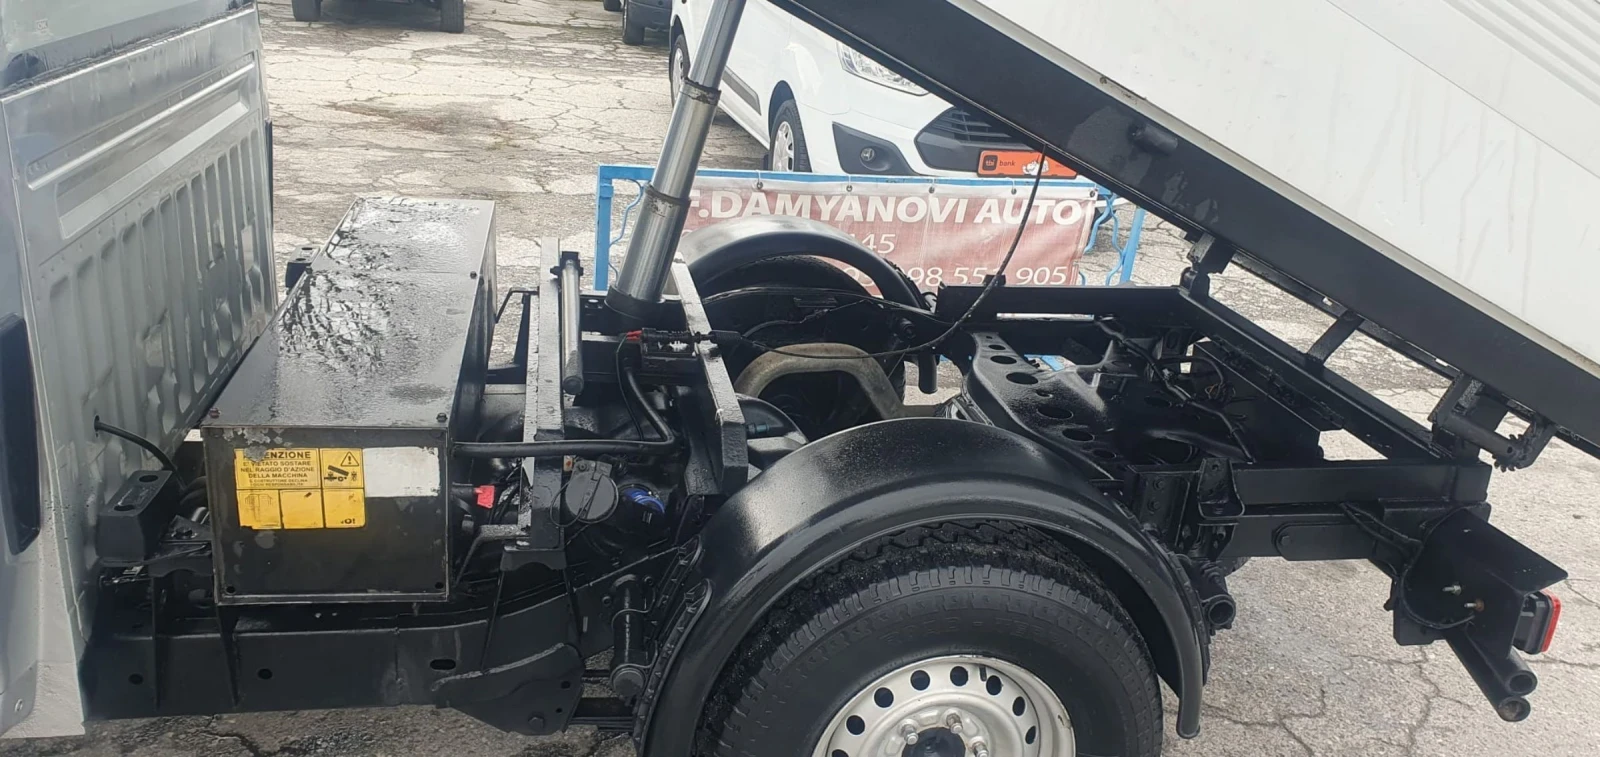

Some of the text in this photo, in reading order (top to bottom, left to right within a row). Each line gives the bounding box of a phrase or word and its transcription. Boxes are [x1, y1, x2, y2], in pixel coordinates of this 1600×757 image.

[973, 197, 1082, 225] AUTO
[1015, 266, 1068, 286] 905
[243, 451, 312, 459] ENZIONE
